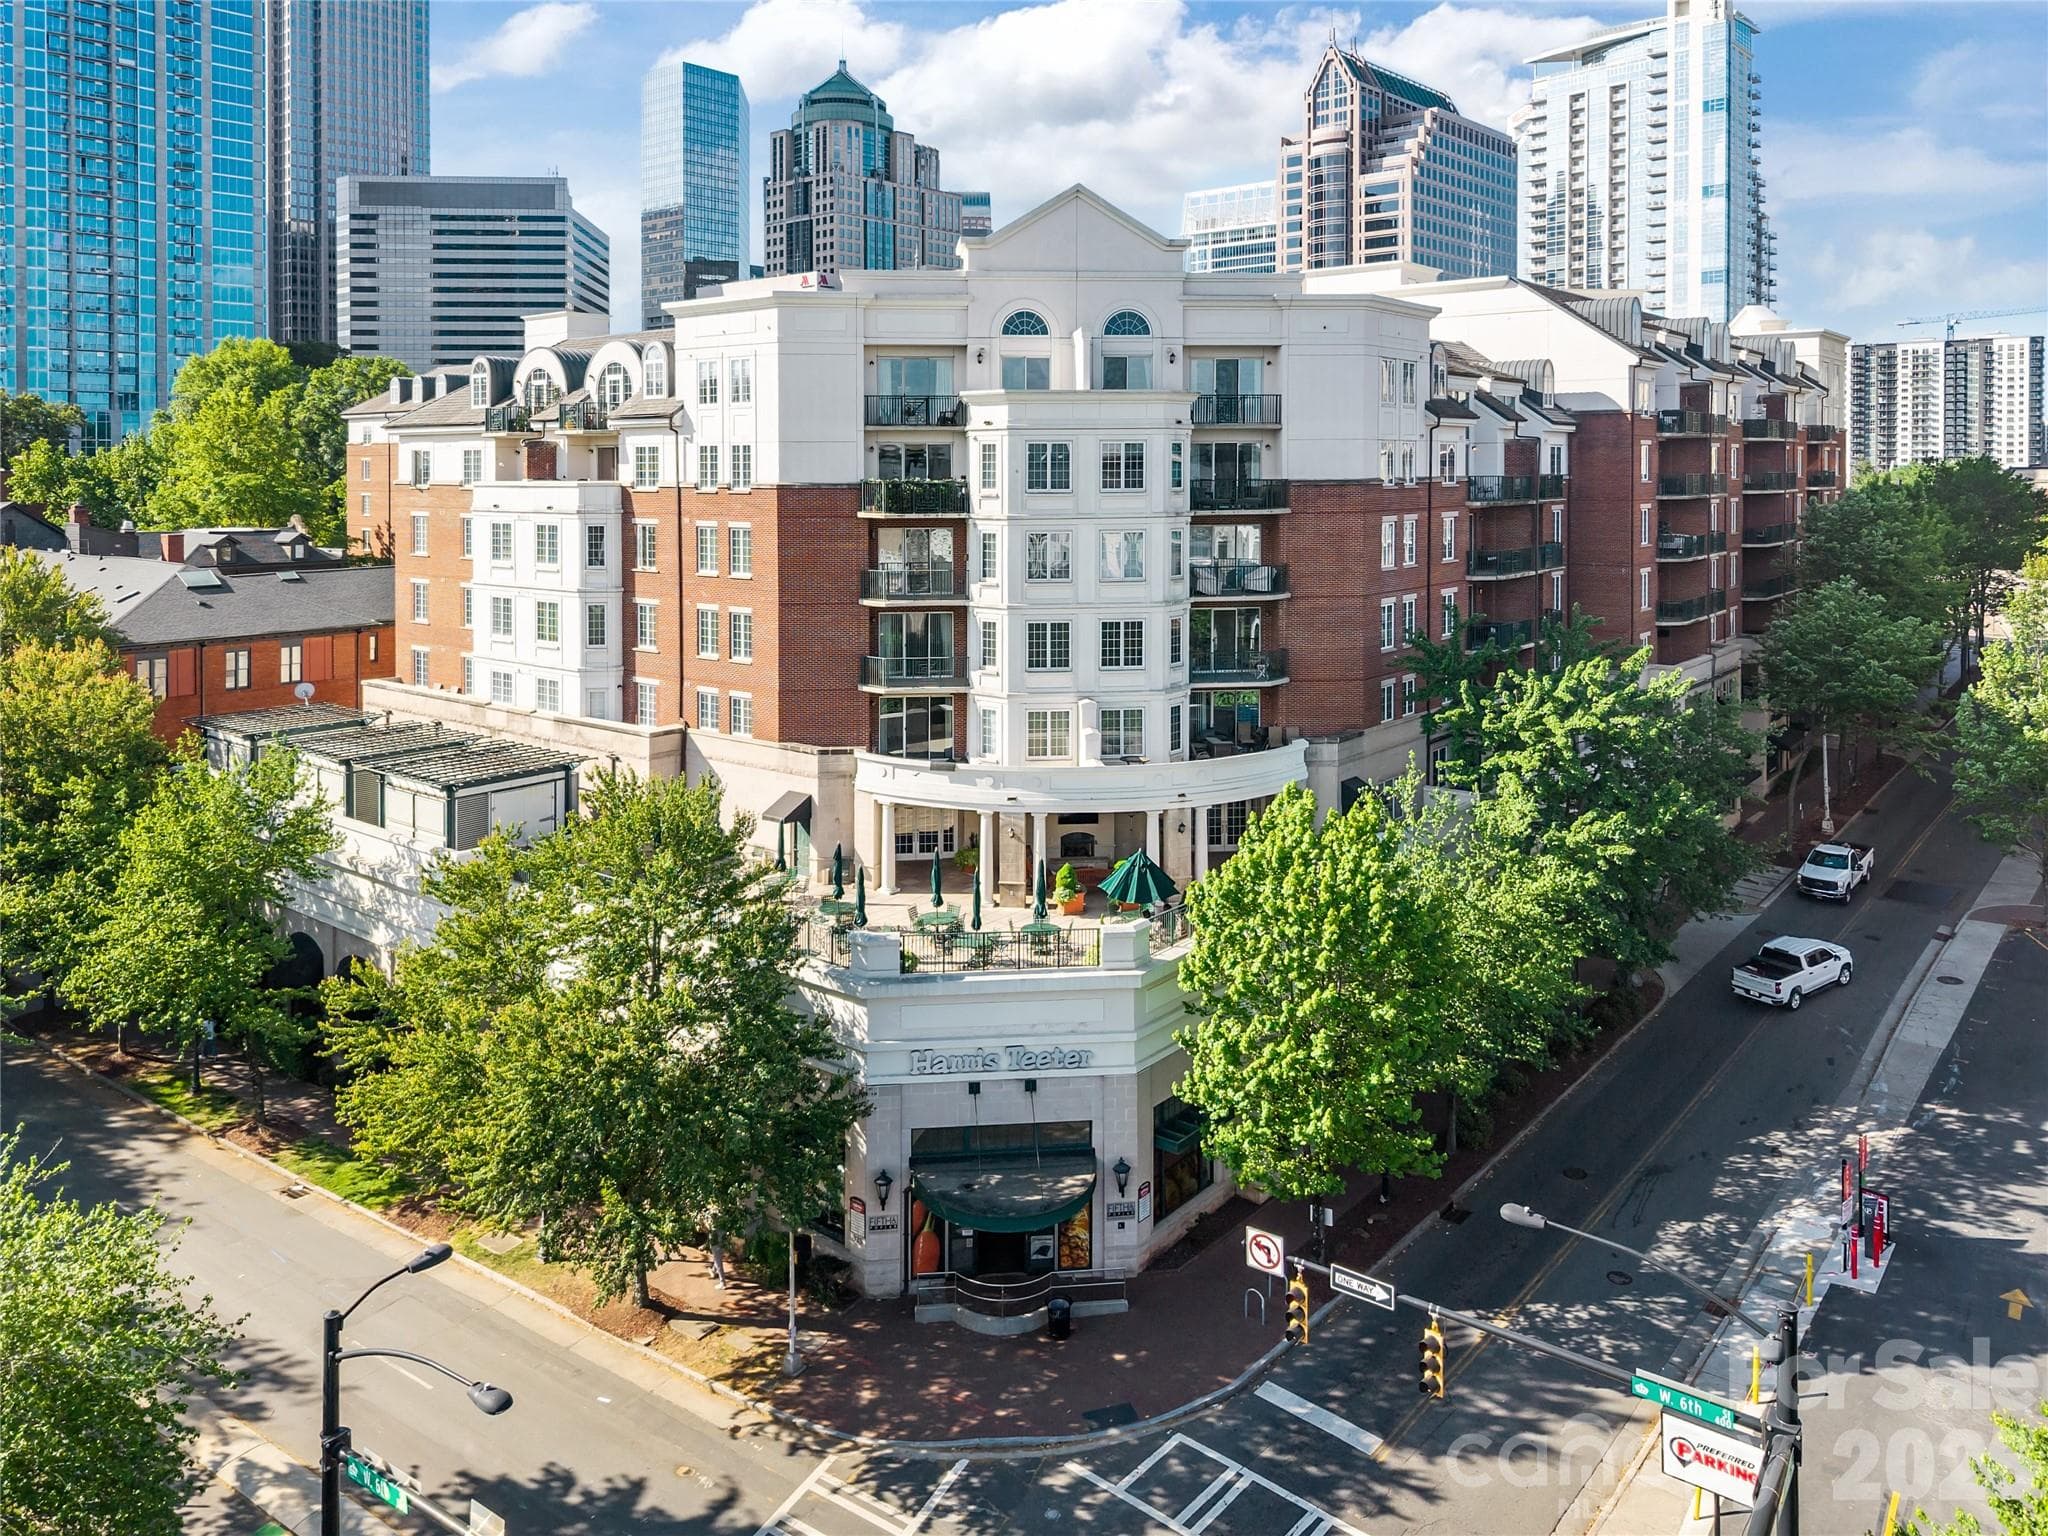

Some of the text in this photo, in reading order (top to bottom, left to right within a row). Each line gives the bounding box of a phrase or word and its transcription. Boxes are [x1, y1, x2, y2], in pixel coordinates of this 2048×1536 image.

[910, 1045, 1095, 1075] Harris Teeter
[1337, 1275, 1373, 1293] ONE WAY
[1659, 1388, 1674, 1406] W.
[1679, 1396, 1702, 1417] 6th
[1677, 1441, 1759, 1486] PARKING
[1696, 1443, 1756, 1470] PREFERRED
